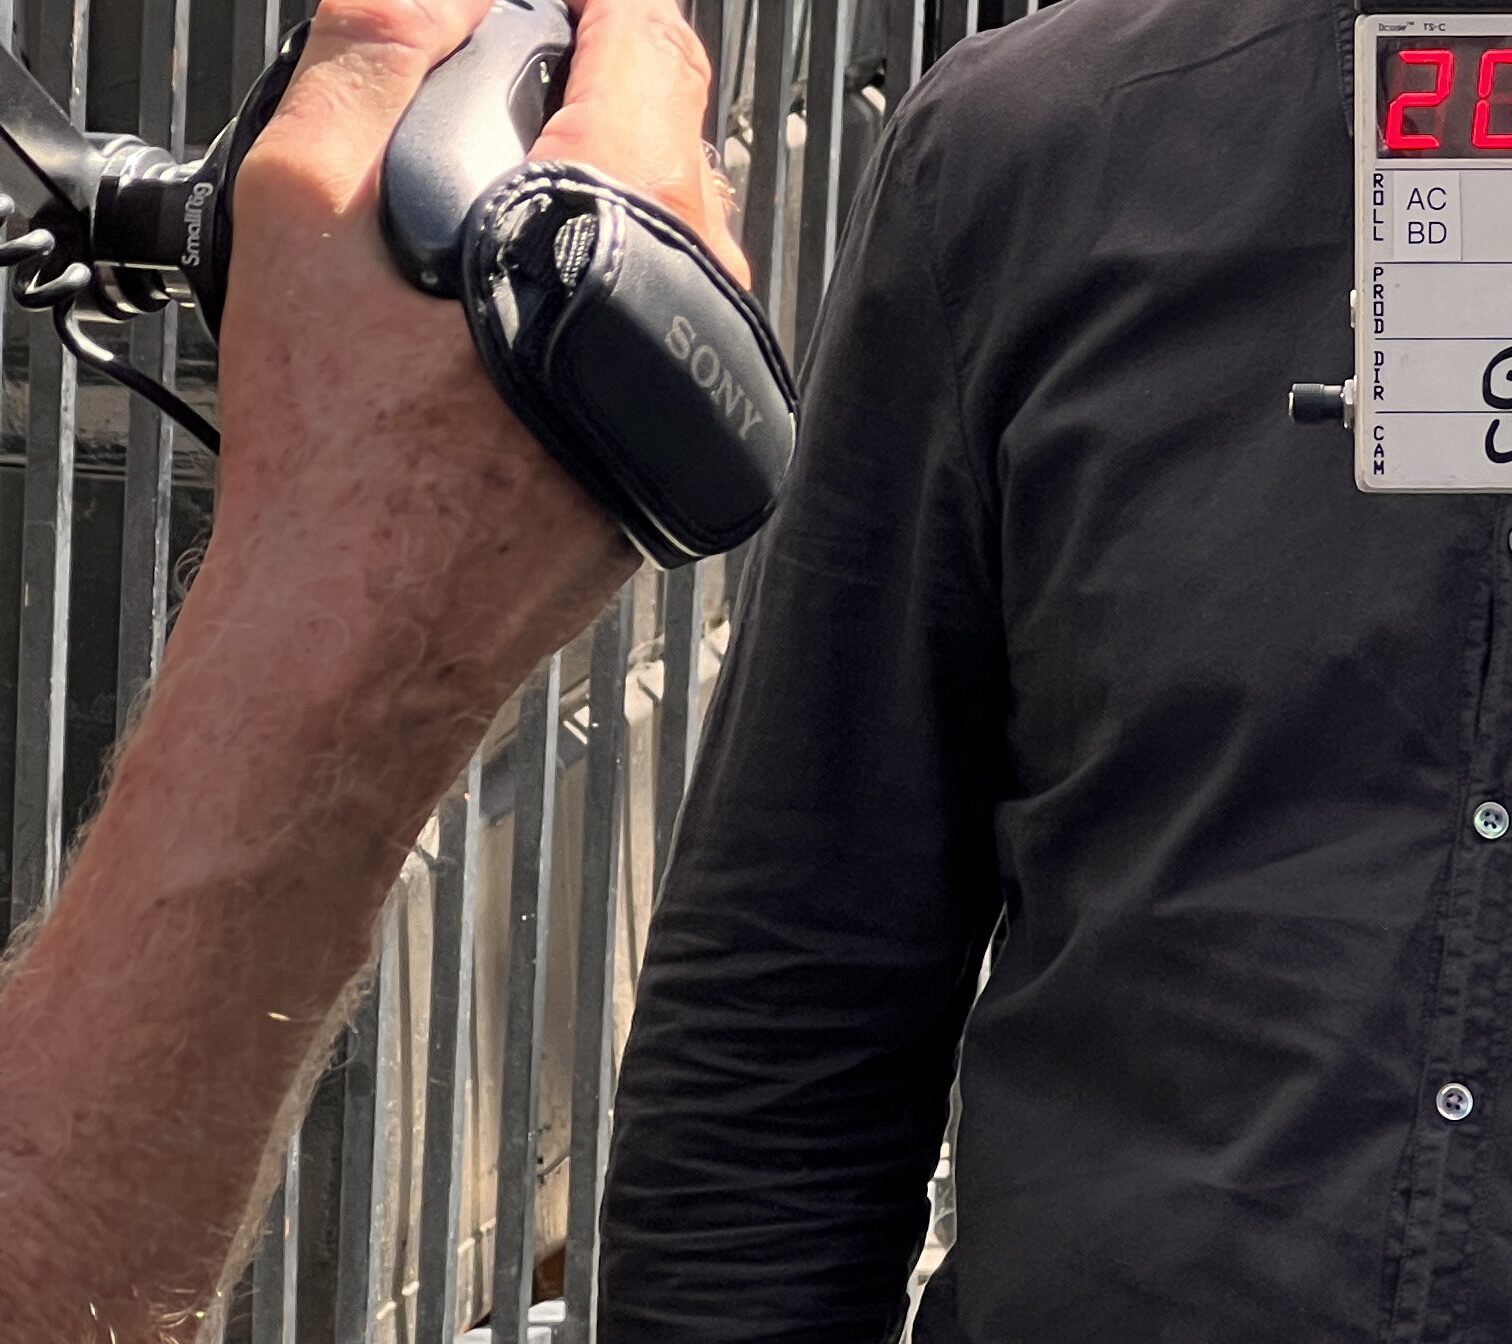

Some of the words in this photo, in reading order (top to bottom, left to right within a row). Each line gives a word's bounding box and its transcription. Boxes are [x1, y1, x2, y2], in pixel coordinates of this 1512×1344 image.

[181, 182, 214, 266] SmallRig
[1373, 173, 1384, 242] ROLL
[1406, 187, 1447, 211] AC
[1407, 221, 1447, 245] BD
[1373, 267, 1384, 334] PROD
[664, 314, 763, 440] SONY
[1374, 351, 1384, 401] DIR
[1373, 426, 1384, 475] CAM
